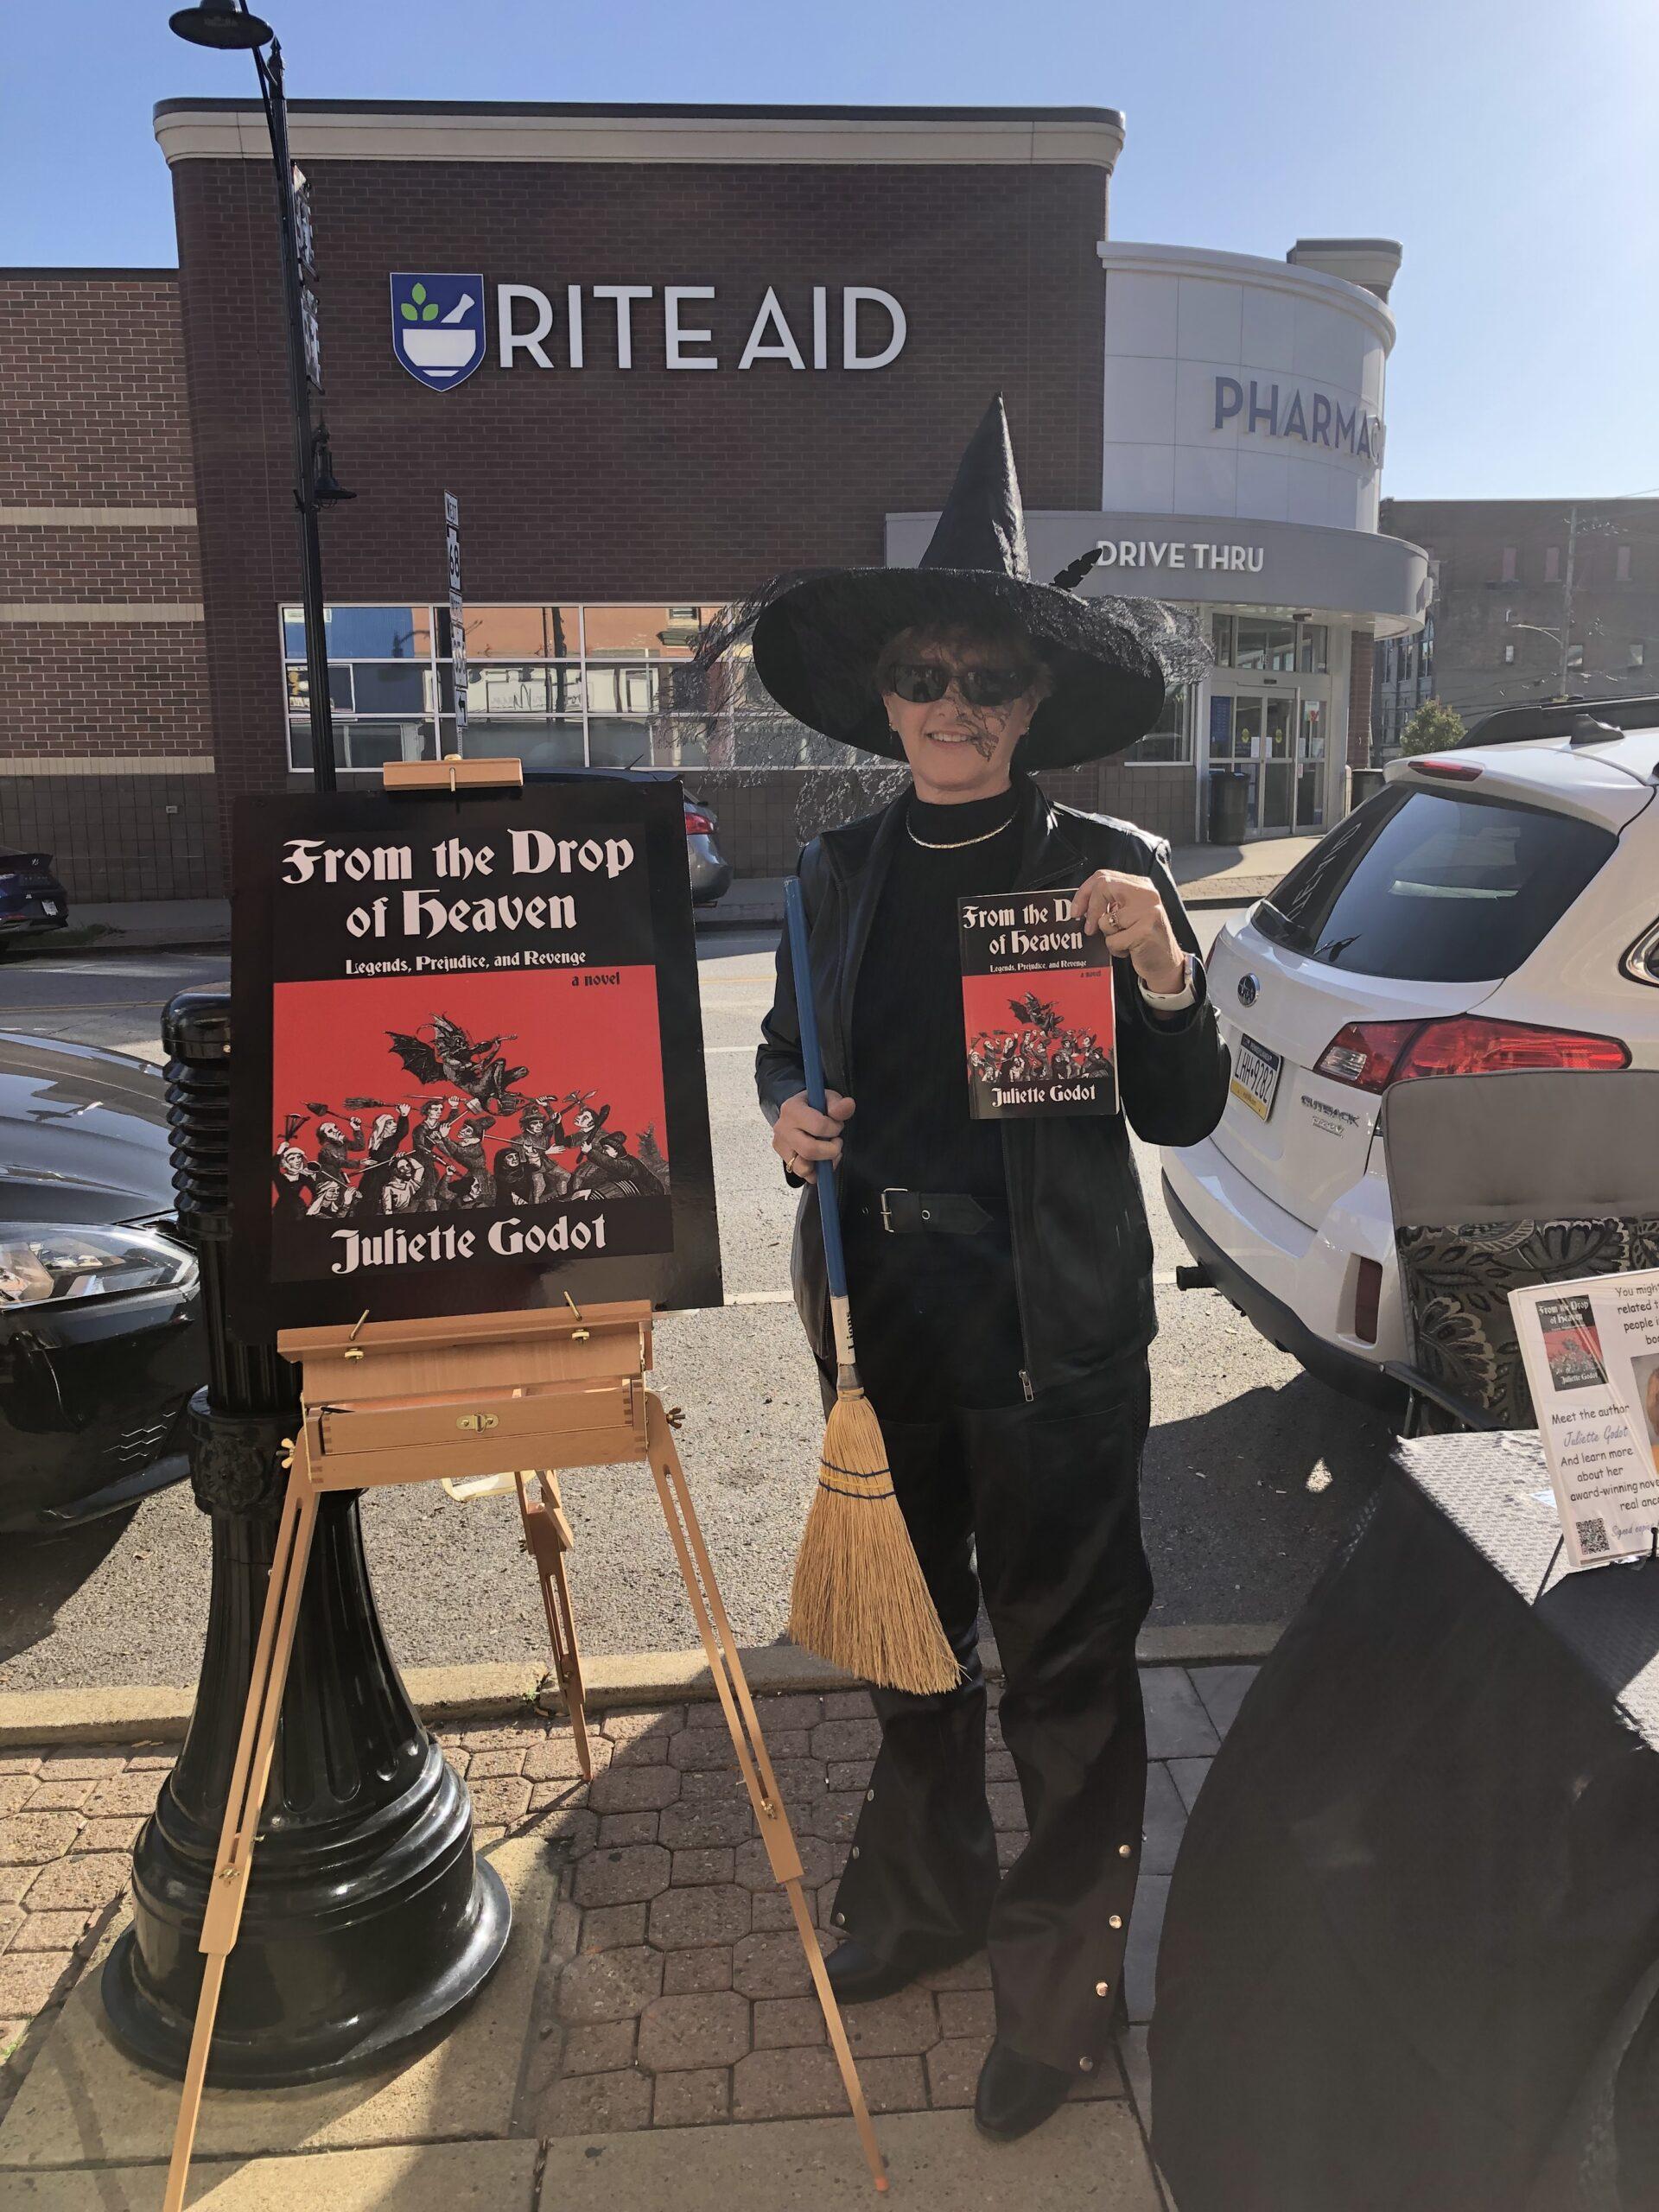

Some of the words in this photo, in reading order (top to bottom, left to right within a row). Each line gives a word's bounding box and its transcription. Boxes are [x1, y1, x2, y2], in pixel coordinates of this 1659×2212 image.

[498, 283, 718, 369] RITE
[738, 285, 907, 369] AID
[449, 544, 460, 578] 68
[1096, 541, 1185, 568] DRIVE
[1190, 544, 1264, 572] THRU
[282, 840, 412, 884] From
[432, 838, 495, 880] the
[506, 829, 634, 879] Drop
[346, 897, 390, 938] of
[403, 889, 577, 939] Heaven
[963, 906, 1015, 929] From
[1022, 903, 1048, 925] the
[989, 933, 1007, 955] of
[1011, 930, 1083, 955] Heaven
[346, 959, 412, 976] Legends,
[416, 954, 489, 972] Prejudice,
[494, 953, 520, 966] and
[524, 950, 586, 965] Revenge
[989, 964, 1017, 973] Legends,
[1060, 959, 1087, 968] Revenge
[571, 976, 579, 987] a
[584, 972, 620, 985] novel
[991, 1084, 1046, 1108] Juliette
[1049, 1084, 1096, 1102] Godot
[331, 1224, 476, 1274] Juliette
[487, 1213, 607, 1255] Godot
[1615, 1287, 1634, 1297] You
[1618, 1299, 1652, 1314] related
[1624, 1317, 1654, 1333] people
[1552, 1414, 1576, 1425] Meet
[1579, 1408, 1596, 1420] the
[1599, 1404, 1630, 1417] author
[1563, 1431, 1600, 1447] Juliette
[1603, 1425, 1629, 1445] Godot
[1560, 1455, 1580, 1467] And
[1581, 1452, 1607, 1464] learn
[1609, 1447, 1633, 1459] more
[1577, 1470, 1604, 1483] about
[1607, 1466, 1624, 1477] her
[1570, 1482, 1638, 1502] award-winning
[1619, 1497, 1639, 1511] real
